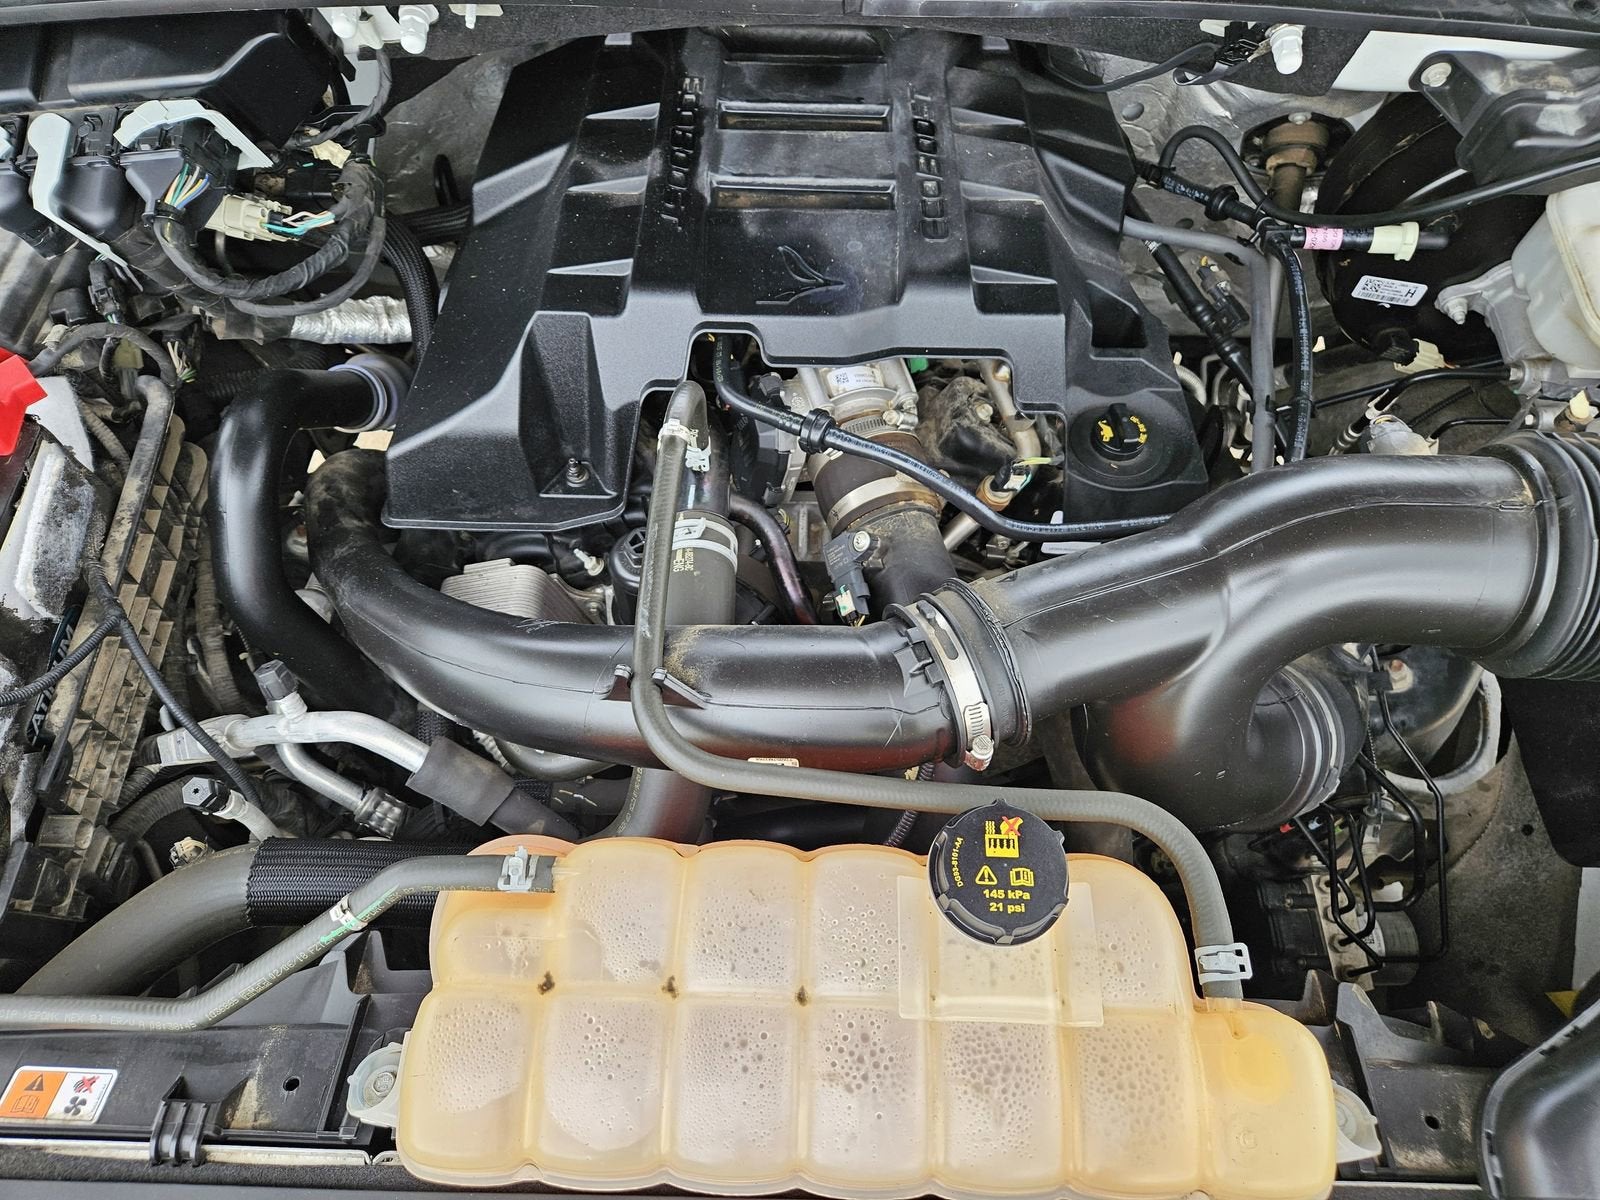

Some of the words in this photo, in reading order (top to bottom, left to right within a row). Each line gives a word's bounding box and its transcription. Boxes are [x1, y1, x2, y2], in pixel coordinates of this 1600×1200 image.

[983, 888, 1005, 899] 145
[1007, 889, 1031, 900] kPa
[989, 902, 1004, 912] 21
[1007, 903, 1026, 914] psi
